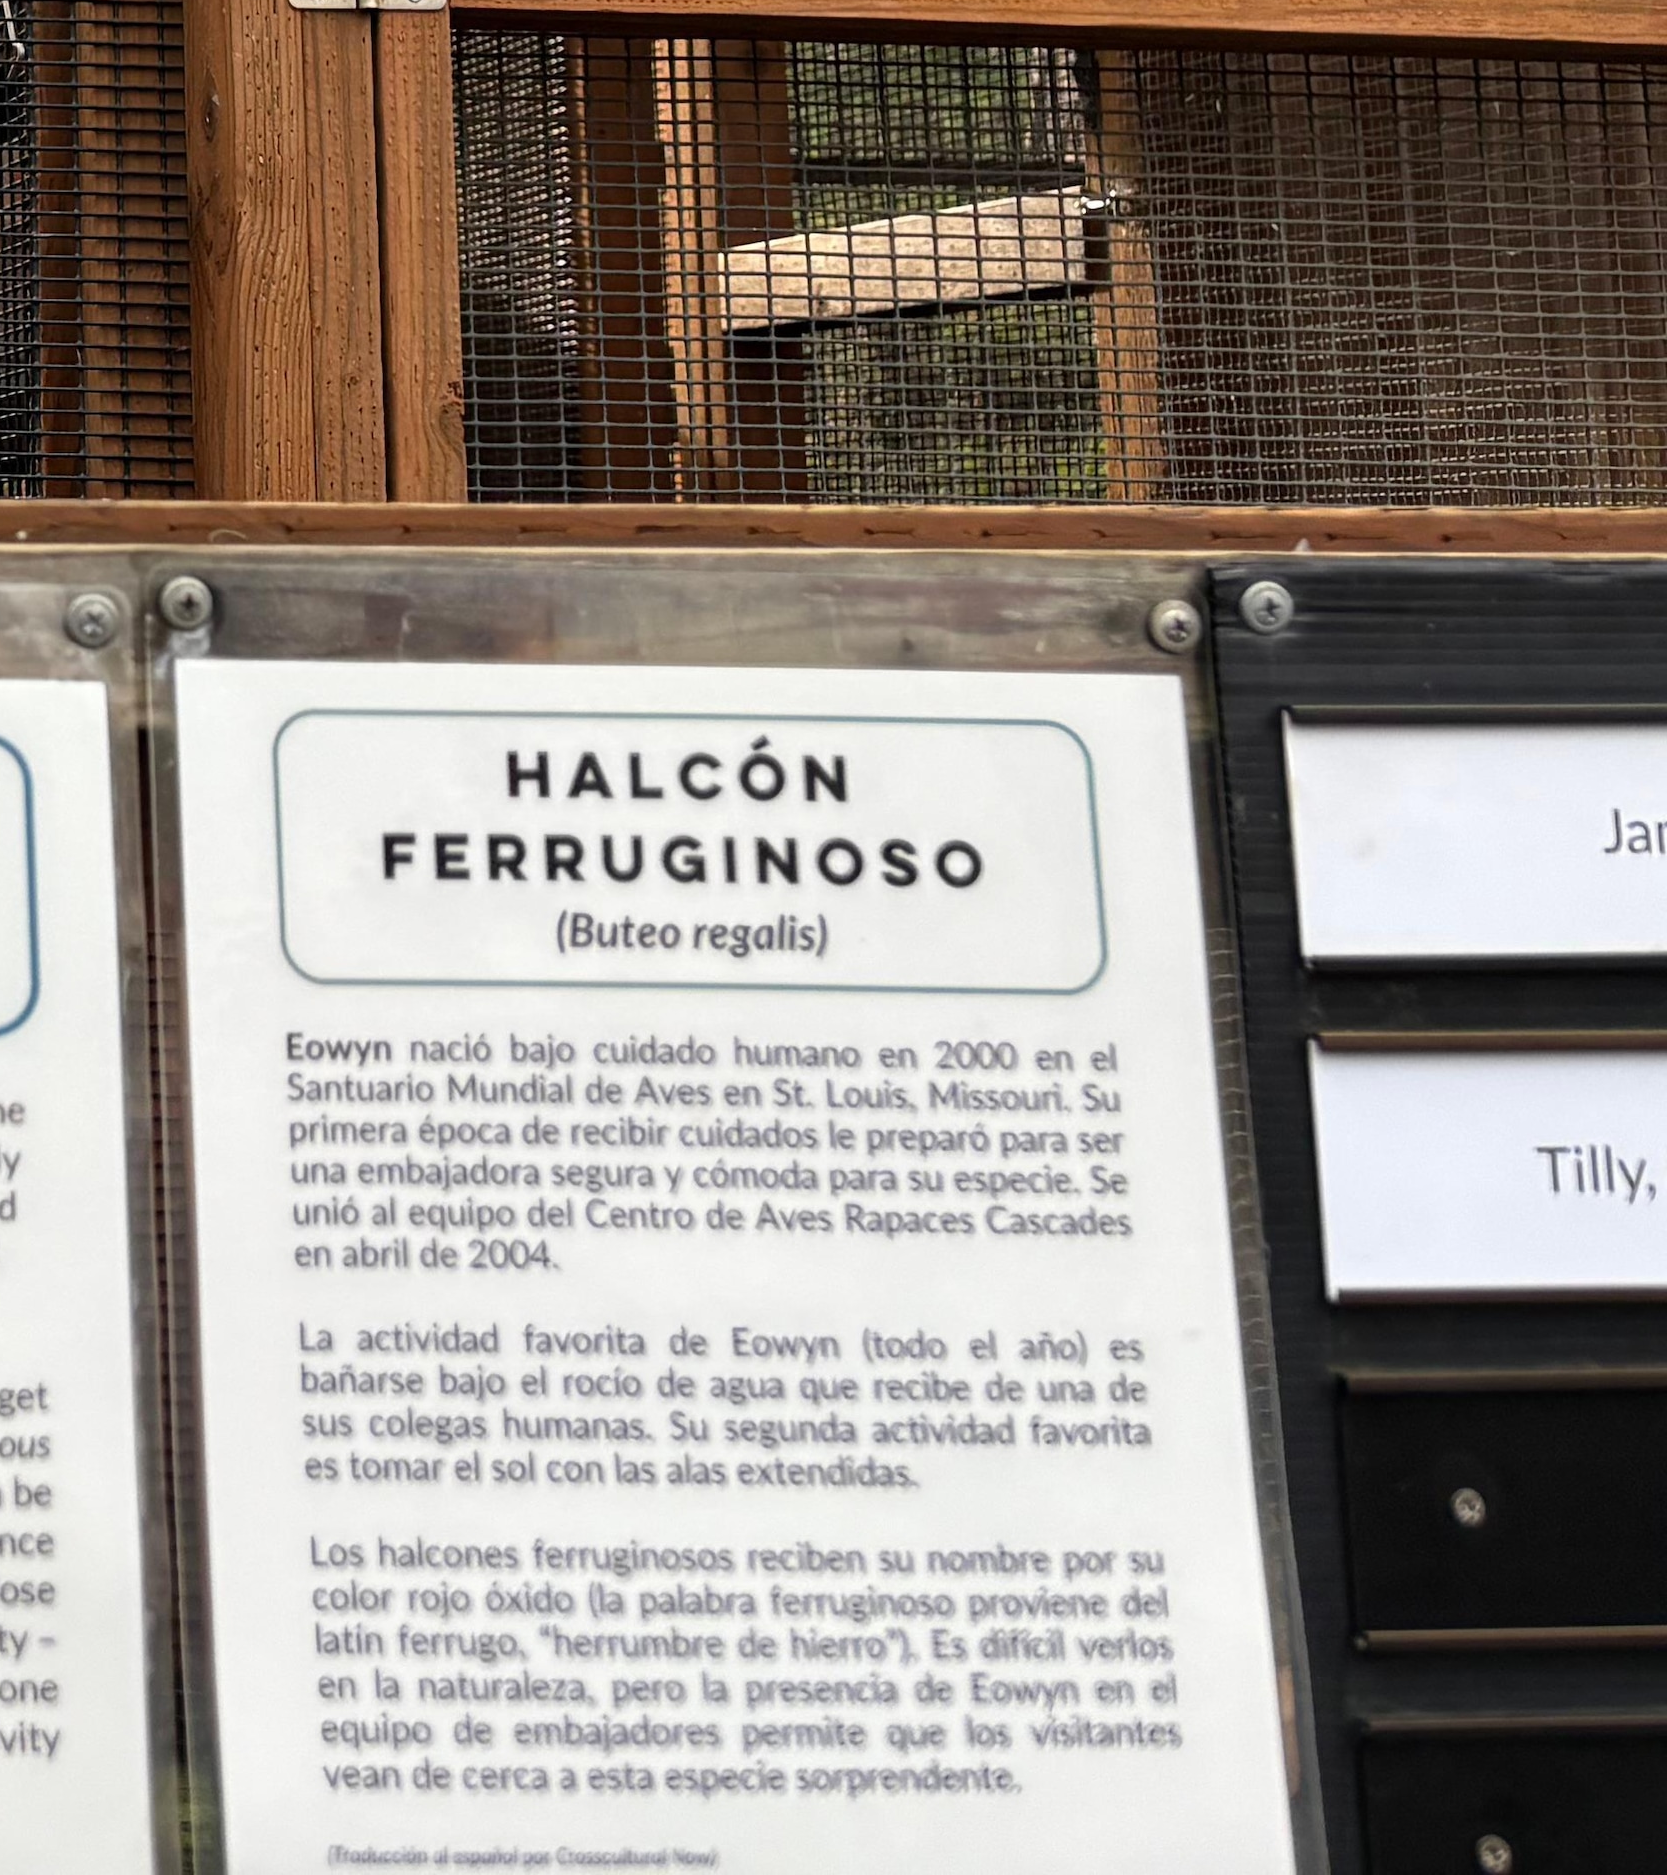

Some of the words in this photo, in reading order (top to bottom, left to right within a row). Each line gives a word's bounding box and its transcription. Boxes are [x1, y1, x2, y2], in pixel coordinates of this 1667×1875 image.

[506, 735, 848, 803] HALCÓN
[382, 832, 982, 889] FERRUGINOSO
[556, 909, 681, 954] (Buteo
[693, 914, 828, 959] regalis)
[286, 1032, 392, 1068] Eowyn
[411, 1034, 492, 1063] nació
[510, 1035, 576, 1071] bajo
[593, 1036, 717, 1067] cuidado
[734, 1037, 862, 1068] humano
[878, 1047, 918, 1070] en
[935, 1040, 1019, 1071] 2000
[1035, 1049, 1074, 1071] en
[1090, 1042, 1117, 1073] el
[287, 1072, 434, 1104] Santuario
[448, 1074, 574, 1105] Mundial
[585, 1075, 623, 1106] de
[634, 1076, 713, 1107] Aves
[723, 1084, 762, 1107] en
[773, 1078, 814, 1109] St.
[826, 1078, 917, 1113] Louis,
[928, 1081, 1071, 1112] Missouri.
[1082, 1083, 1121, 1113] Su
[289, 1114, 408, 1150] primera
[418, 1115, 512, 1151] época
[522, 1116, 560, 1147] de
[571, 1117, 669, 1148] recibir
[679, 1119, 820, 1151] cuidados
[828, 1120, 856, 1151] le
[866, 1123, 991, 1158] preparó
[1000, 1131, 1068, 1159] para
[1077, 1132, 1124, 1155] ser
[291, 1162, 347, 1185] una
[357, 1157, 541, 1193] embajadora
[551, 1164, 655, 1194] segura
[664, 1166, 683, 1194] y
[693, 1160, 819, 1191] cómoda
[829, 1169, 898, 1197] para
[908, 1170, 944, 1193] su
[953, 1164, 1081, 1201] especie.
[1090, 1165, 1128, 1196] Se
[1535, 1145, 1657, 1205] Tilly,
[293, 1196, 360, 1228] unió
[372, 1197, 397, 1228] al
[408, 1198, 516, 1234] equipo
[527, 1199, 574, 1229] del
[585, 1200, 696, 1231] Centro
[706, 1201, 745, 1231] de
[755, 1202, 834, 1233] Aves
[845, 1203, 976, 1240] Rapaces
[985, 1205, 1133, 1237] Cascades
[294, 1245, 332, 1269] en
[343, 1238, 409, 1269] abril
[420, 1239, 458, 1270] de
[469, 1239, 559, 1270] 2004.
[300, 1323, 333, 1354] La
[357, 1324, 500, 1355] actividad
[523, 1325, 647, 1357] favorita
[669, 1327, 709, 1357] de
[732, 1327, 841, 1364] Eowyn
[862, 1329, 948, 1364] (todo
[969, 1330, 997, 1361] el
[1020, 1331, 1088, 1367] año)
[1109, 1339, 1144, 1363] es
[14, 1475, 53, 1510] be
[311, 1538, 365, 1569] Los
[379, 1539, 520, 1571] halcones
[532, 1540, 735, 1577] ferruginosos
[748, 1542, 867, 1574] reciben
[879, 1550, 915, 1574] su
[928, 1544, 1051, 1575] nombre
[1063, 1551, 1116, 1580] por
[1128, 1551, 1165, 1575] su
